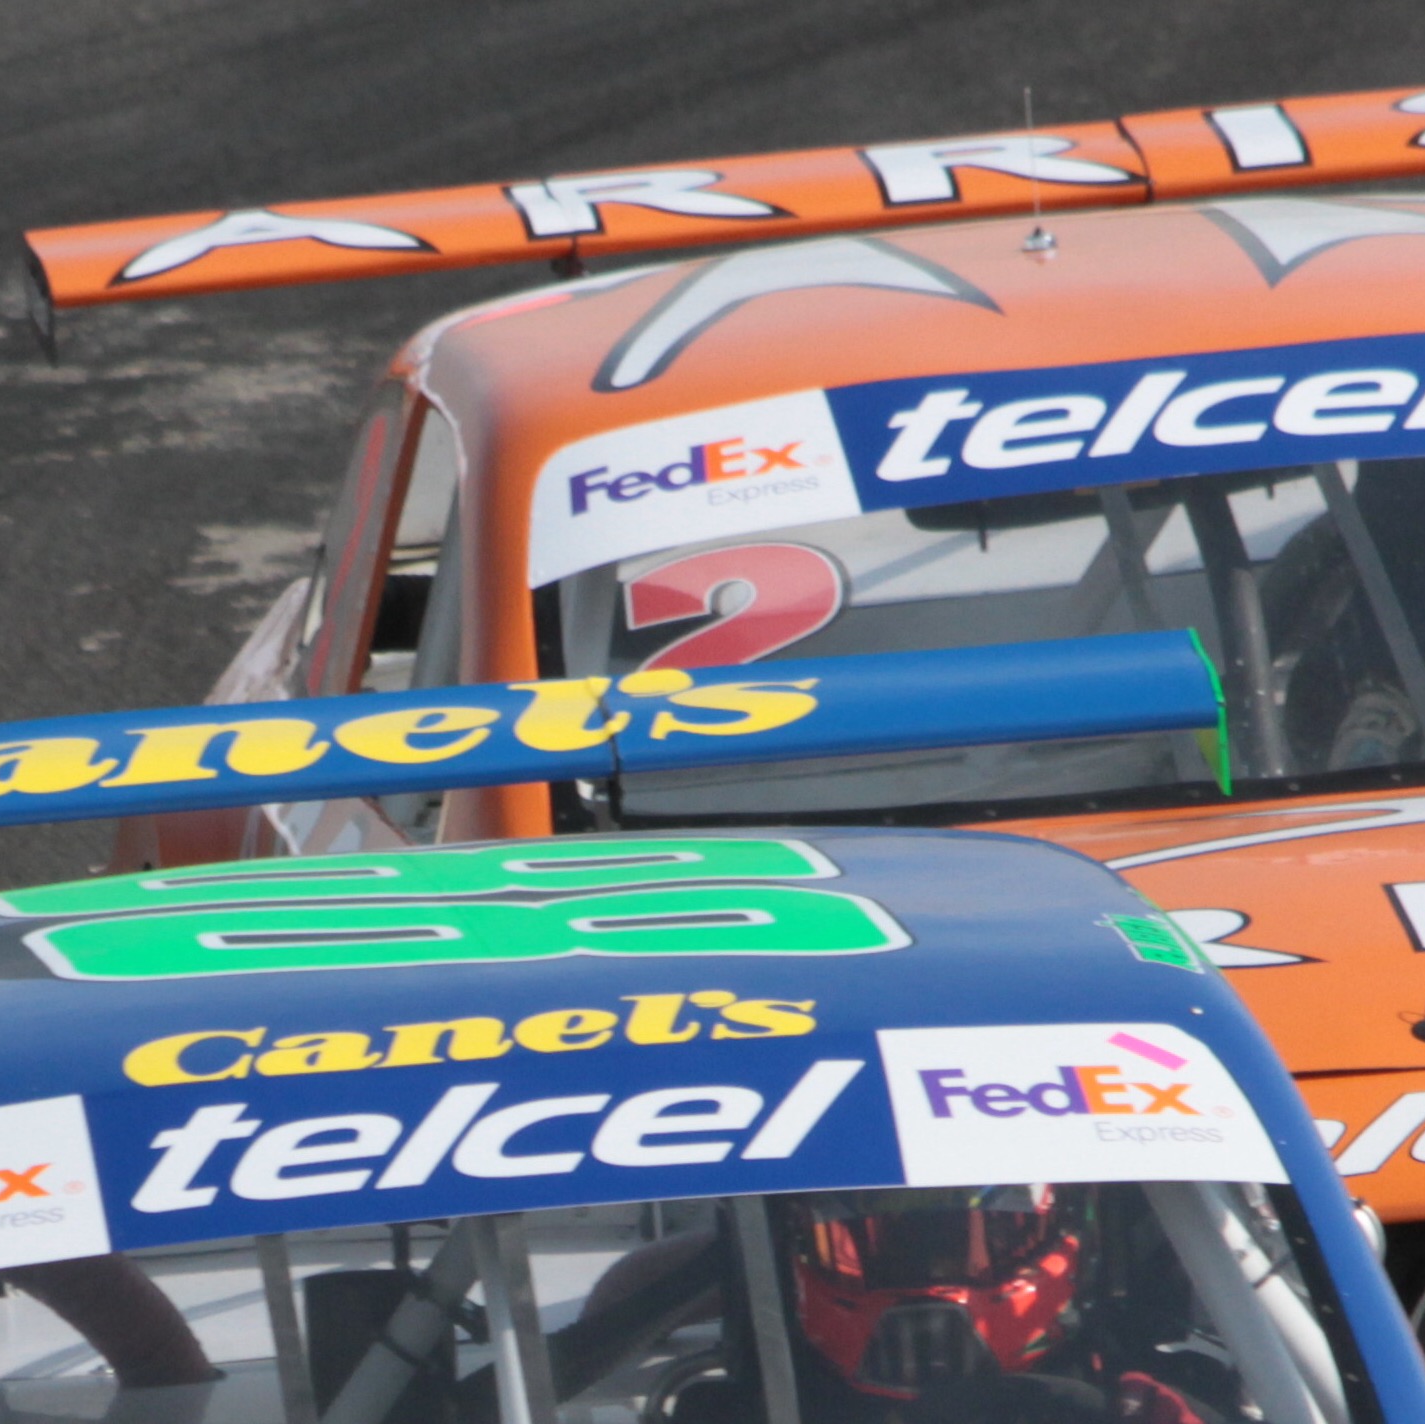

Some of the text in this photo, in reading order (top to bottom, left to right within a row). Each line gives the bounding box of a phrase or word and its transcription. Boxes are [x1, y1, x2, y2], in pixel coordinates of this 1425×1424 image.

[569, 437, 806, 516] FedEx
[707, 475, 820, 507] Express
[122, 989, 817, 1087] Canel's
[917, 1064, 1203, 1118] FedEx
[130, 1059, 865, 1212] telcel
[1094, 1121, 1225, 1146] Express
